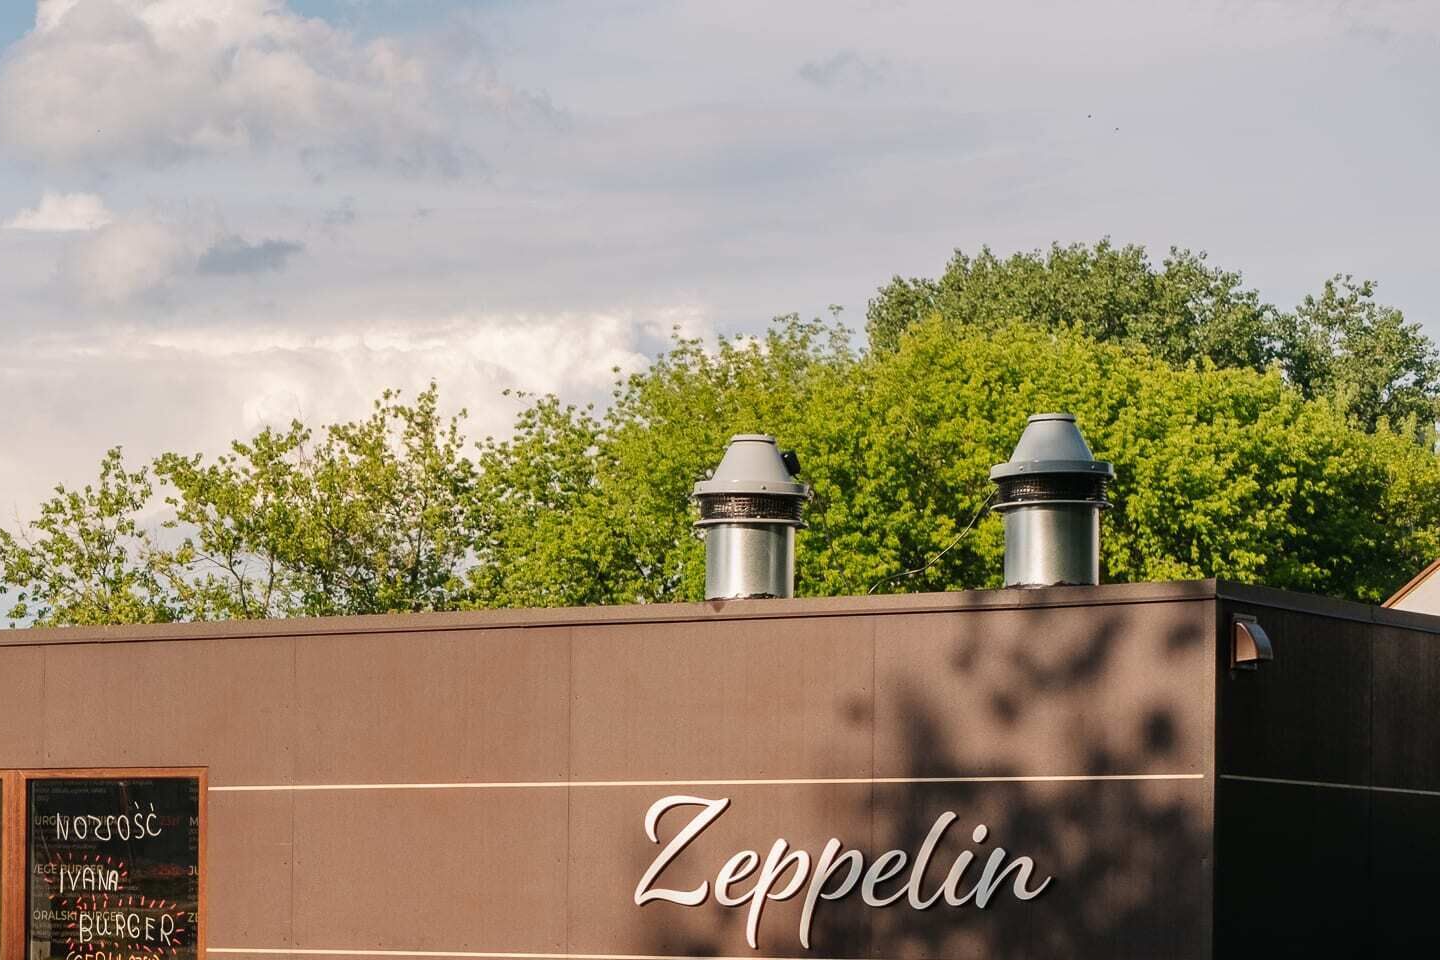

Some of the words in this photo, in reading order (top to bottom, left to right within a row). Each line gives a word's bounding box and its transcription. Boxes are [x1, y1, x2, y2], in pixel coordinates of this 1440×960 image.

[59, 866, 120, 894] IVANA
[634, 795, 1052, 949] Zeppelin
[78, 912, 174, 946] BURGER
